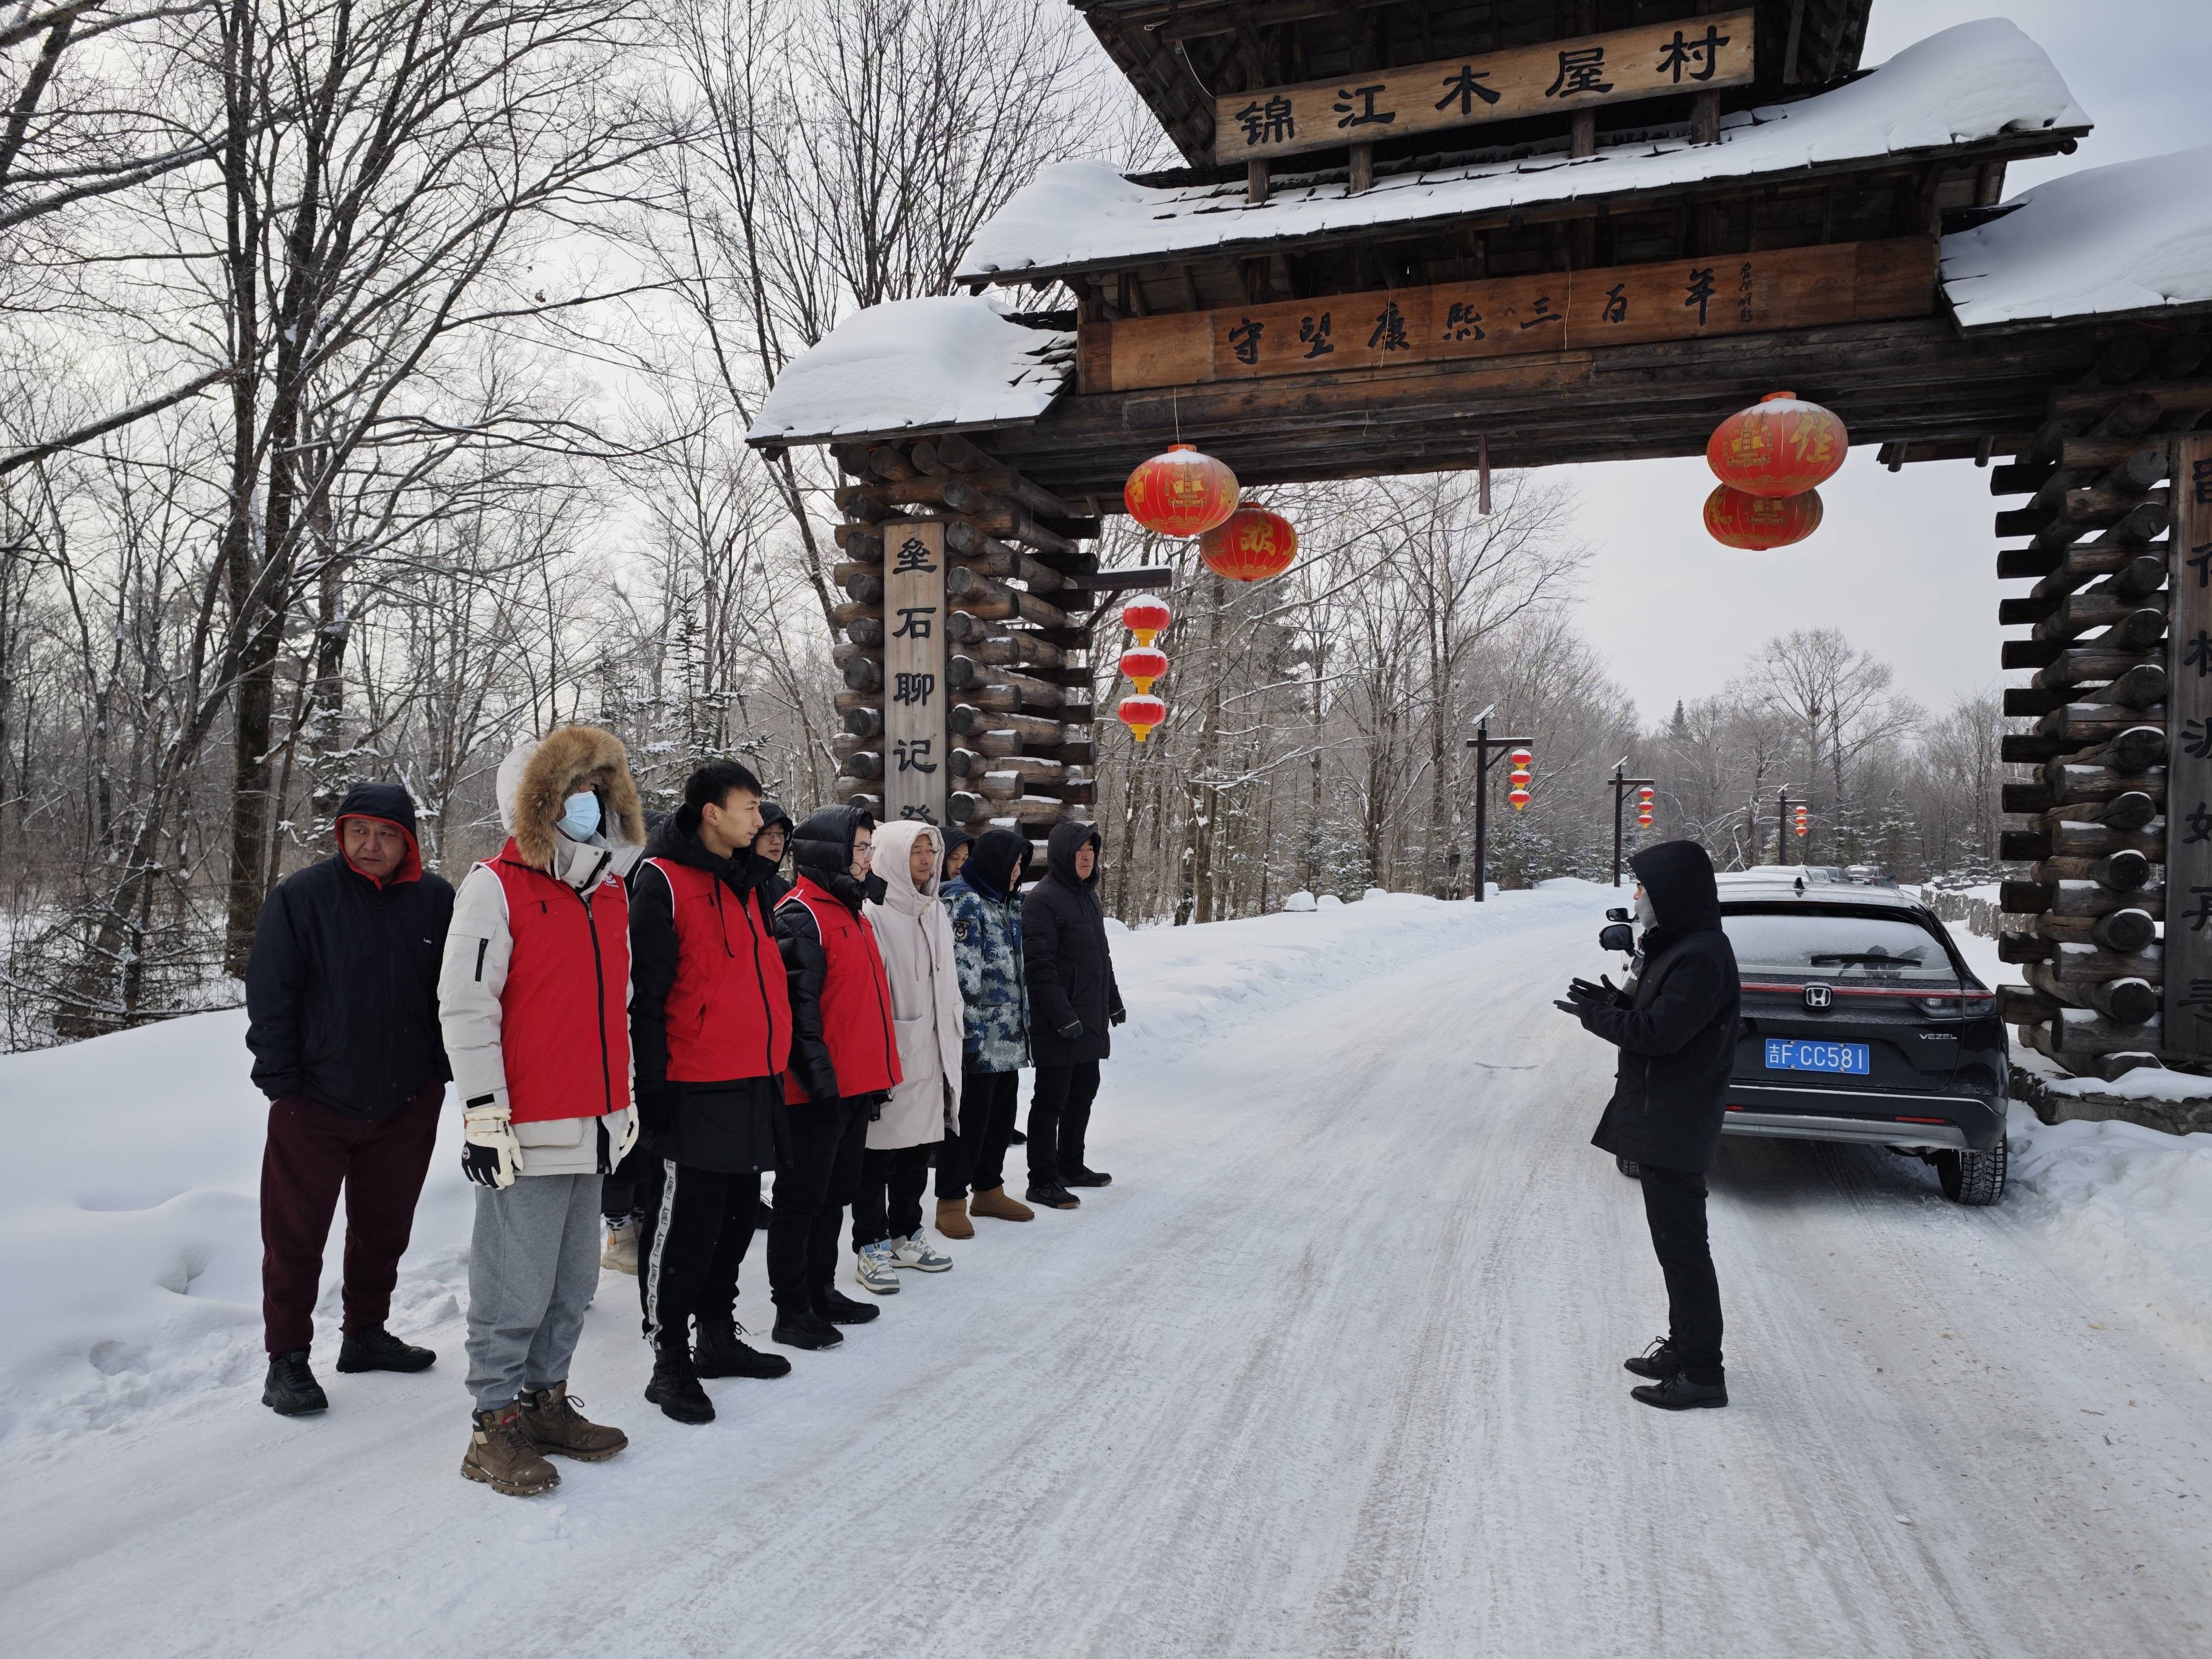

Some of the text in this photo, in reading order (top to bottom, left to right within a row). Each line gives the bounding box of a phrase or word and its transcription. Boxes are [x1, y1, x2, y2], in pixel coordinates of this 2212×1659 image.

[1235, 25, 1730, 146] 锦江木屋村
[1228, 268, 1716, 365] 守望康熙三百年
